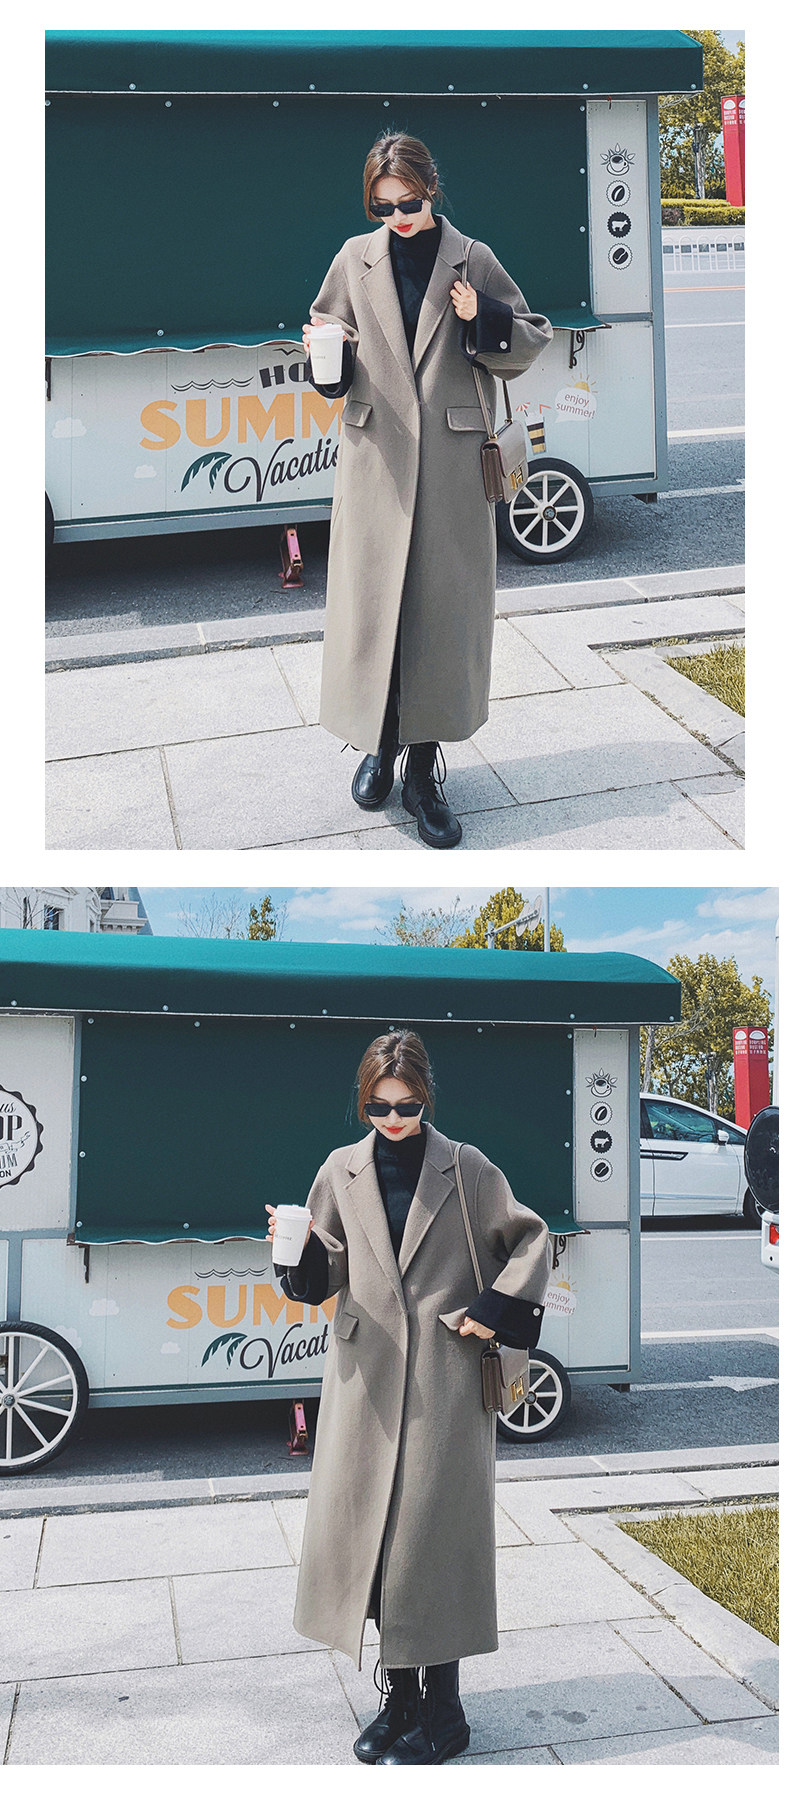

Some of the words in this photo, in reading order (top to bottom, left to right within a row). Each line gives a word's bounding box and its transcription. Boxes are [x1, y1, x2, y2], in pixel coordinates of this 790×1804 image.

[564, 393, 590, 408] enjoy
[556, 403, 596, 419] summer!
[139, 389, 345, 450] SUMM
[547, 1292, 570, 1305] enjoy
[543, 1301, 576, 1316] ummer!
